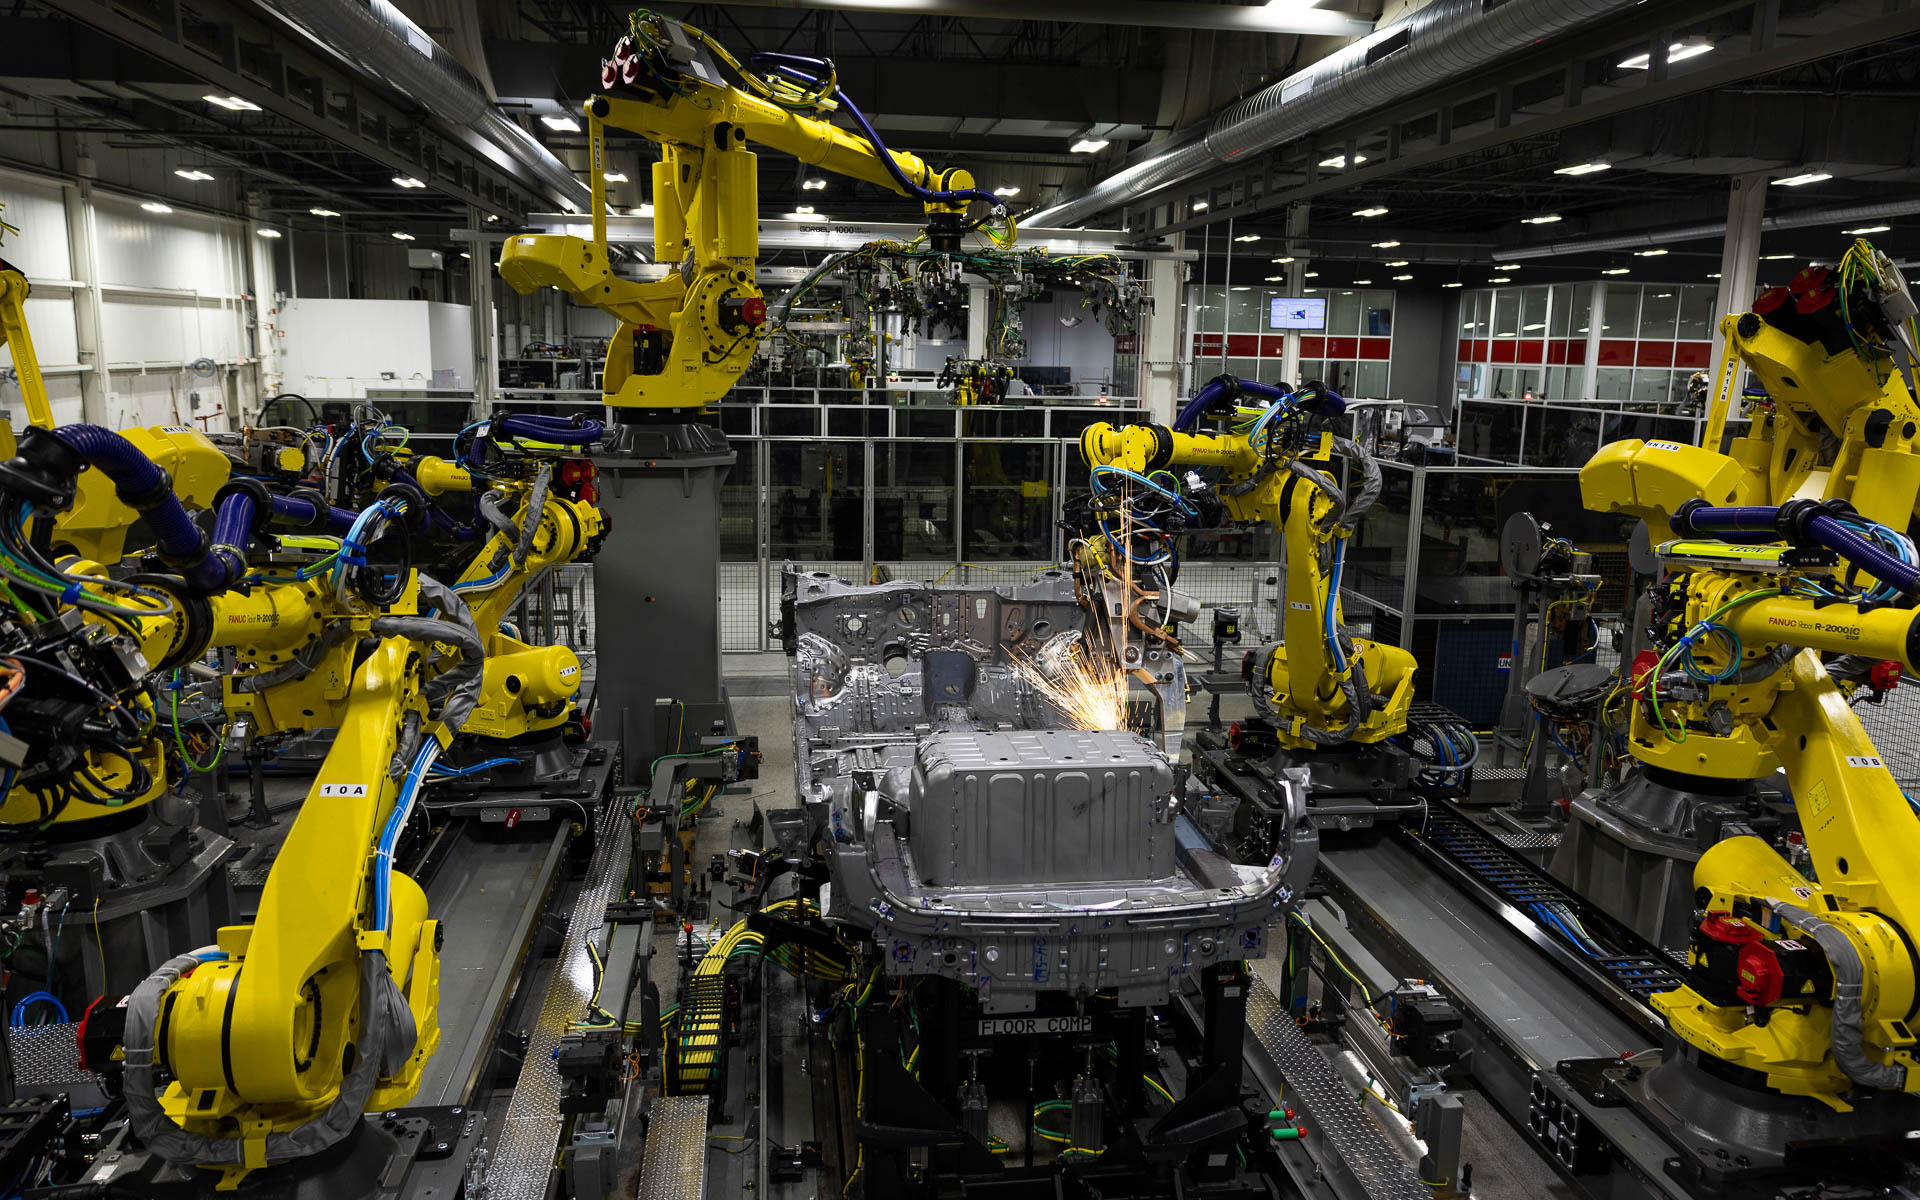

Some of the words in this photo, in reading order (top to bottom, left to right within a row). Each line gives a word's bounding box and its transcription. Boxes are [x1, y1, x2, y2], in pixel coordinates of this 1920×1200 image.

[1721, 362, 1734, 400] MH12B
[228, 615, 247, 624] FANUC
[1768, 617, 1797, 627] FANUC
[1850, 758, 1880, 766] 10B
[324, 786, 363, 795] 10A
[981, 1020, 1037, 1034] FLOOR
[1047, 1017, 1091, 1032] COMP
